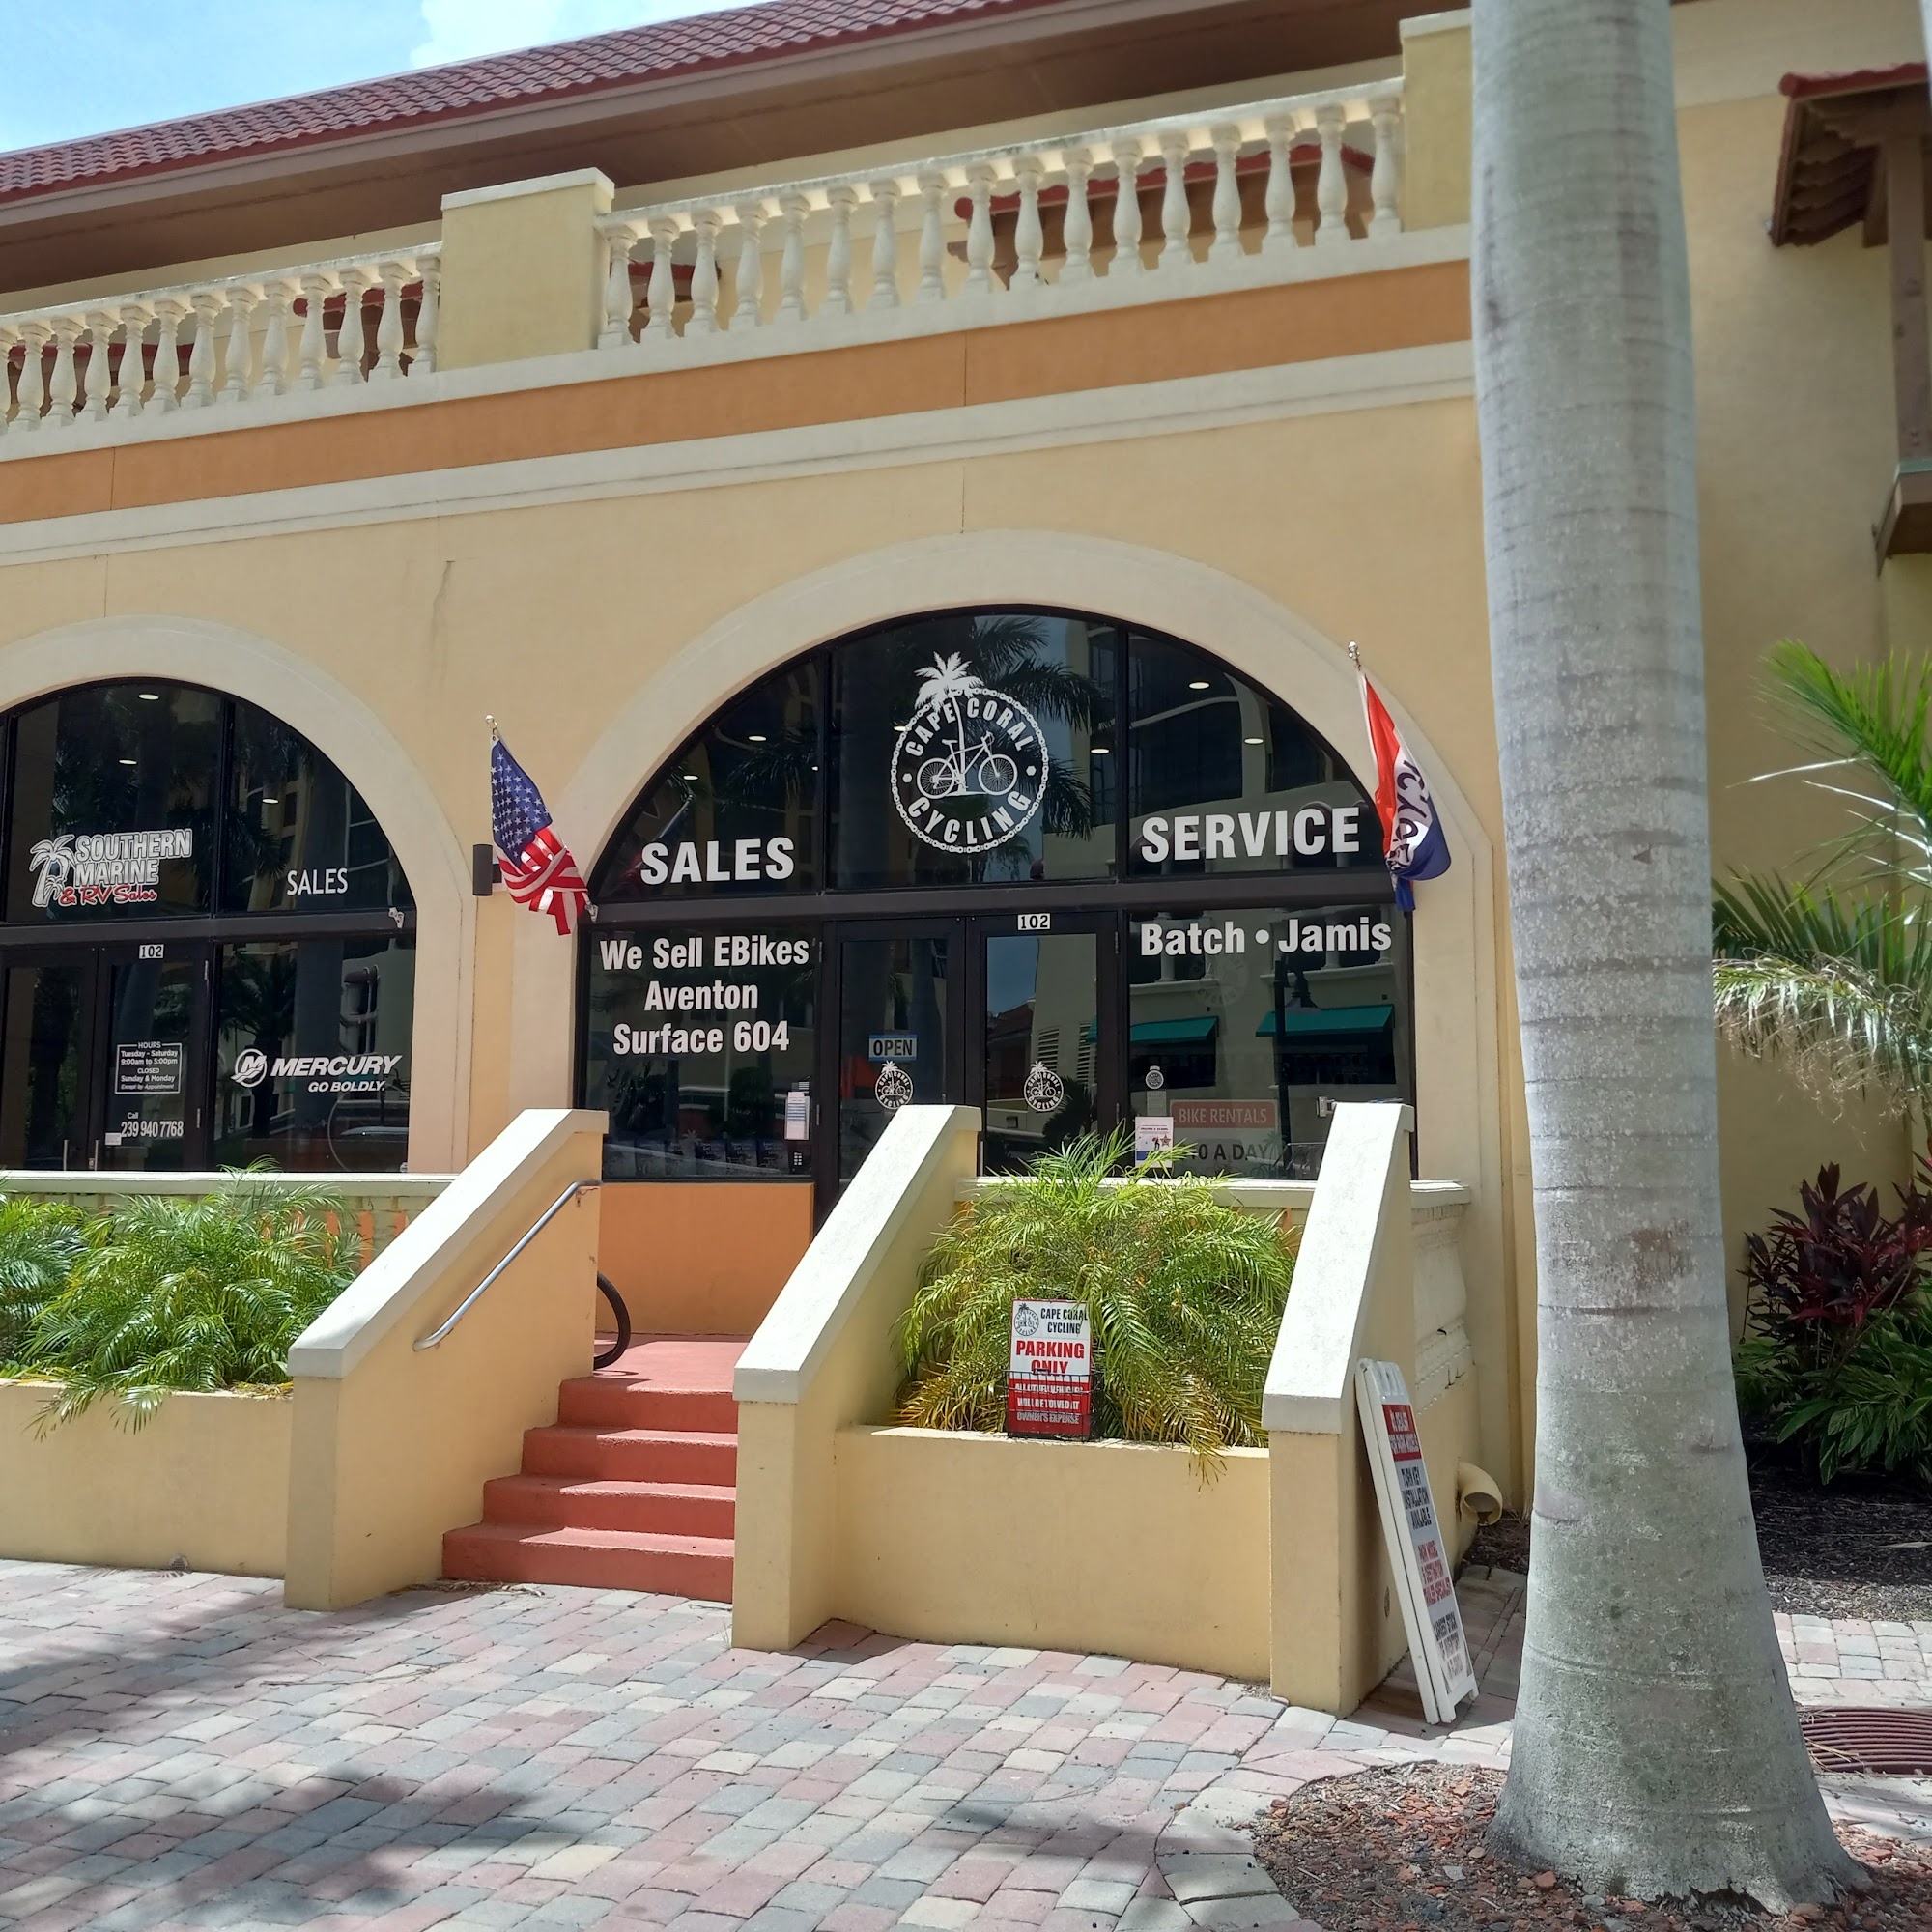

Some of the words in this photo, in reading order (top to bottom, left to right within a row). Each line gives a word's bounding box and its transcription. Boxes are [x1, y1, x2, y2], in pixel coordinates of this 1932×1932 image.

[906, 703, 956, 756] CAPE
[967, 697, 1034, 752] CORAL
[907, 790, 1032, 844] CYCLING
[75, 828, 193, 862] SOUTHERN
[1140, 807, 1360, 863] SERVICE
[640, 837, 795, 885] SALES
[74, 859, 159, 889] MARINE
[286, 868, 348, 895] SALES
[59, 886, 77, 906] &
[80, 886, 114, 905] RV
[114, 884, 157, 904] Sales
[1019, 915, 1049, 929] 102
[1141, 921, 1244, 956] Batch
[1278, 916, 1392, 953] Jamis
[141, 946, 162, 957] 102
[600, 939, 643, 970] We
[653, 937, 703, 968] Sell
[714, 935, 810, 967] EBikes
[643, 980, 759, 1011] Aventon
[612, 1023, 723, 1055] Surface
[734, 1020, 790, 1052] 604
[873, 1039, 913, 1056] OPEN
[270, 1055, 403, 1076] MERCURY
[308, 1082, 328, 1093] GO
[330, 1080, 386, 1092] BOLDLY.
[1179, 1108, 1207, 1123] BIKE
[1209, 1108, 1267, 1123] RENTALS
[121, 1121, 139, 1137] 239
[140, 1121, 158, 1137] 940
[160, 1121, 184, 1137] 7768
[1214, 1144, 1227, 1160] A
[1233, 1144, 1268, 1160] DAY
[1041, 1308, 1061, 1320] CAPE
[1063, 1308, 1088, 1321] CORAL
[1047, 1321, 1081, 1334] CYCLING
[1016, 1340, 1085, 1359] PARKING
[1032, 1359, 1068, 1377] ONLY
[1035, 1399, 1043, 1407] BE
